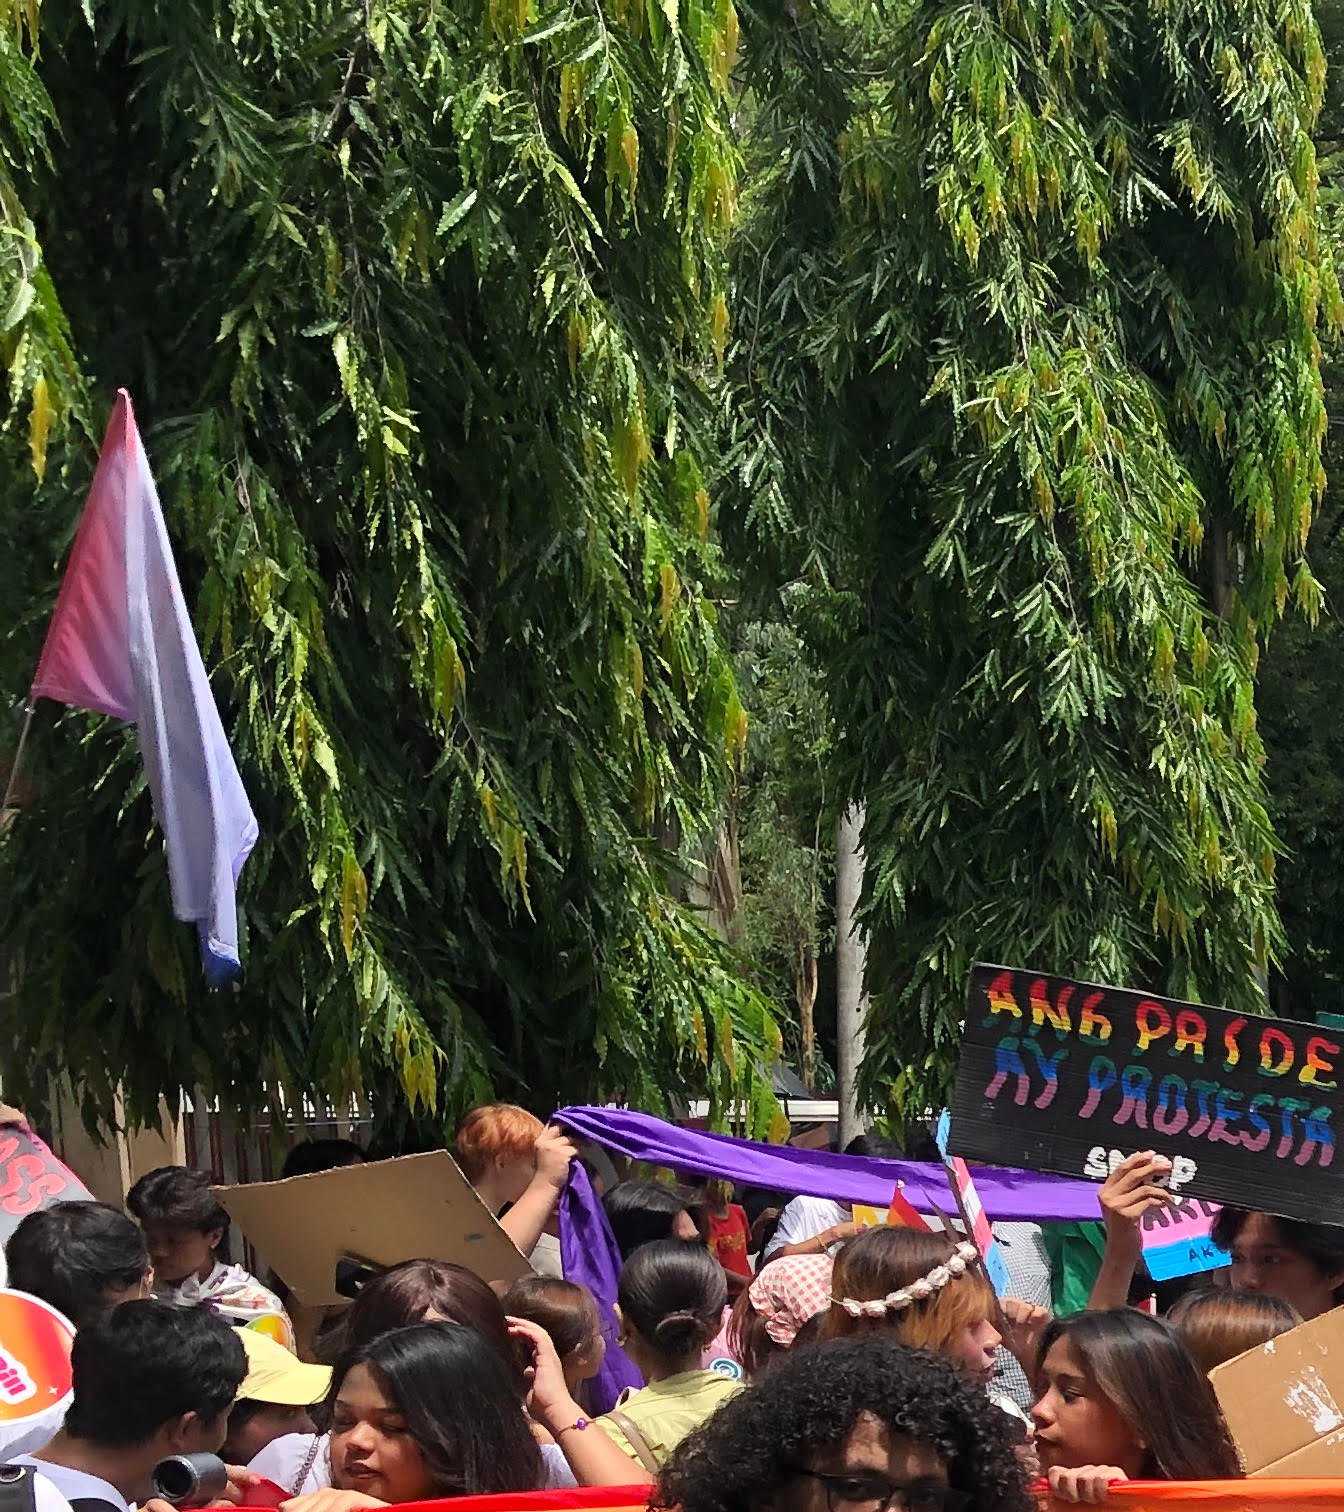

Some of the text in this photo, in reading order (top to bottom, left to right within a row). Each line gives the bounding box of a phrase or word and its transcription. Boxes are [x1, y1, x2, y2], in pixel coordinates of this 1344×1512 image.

[1132, 1000, 1340, 1089] PRIDE
[984, 1037, 1069, 1109] AY
[1078, 1055, 1337, 1168] PROTESTA
